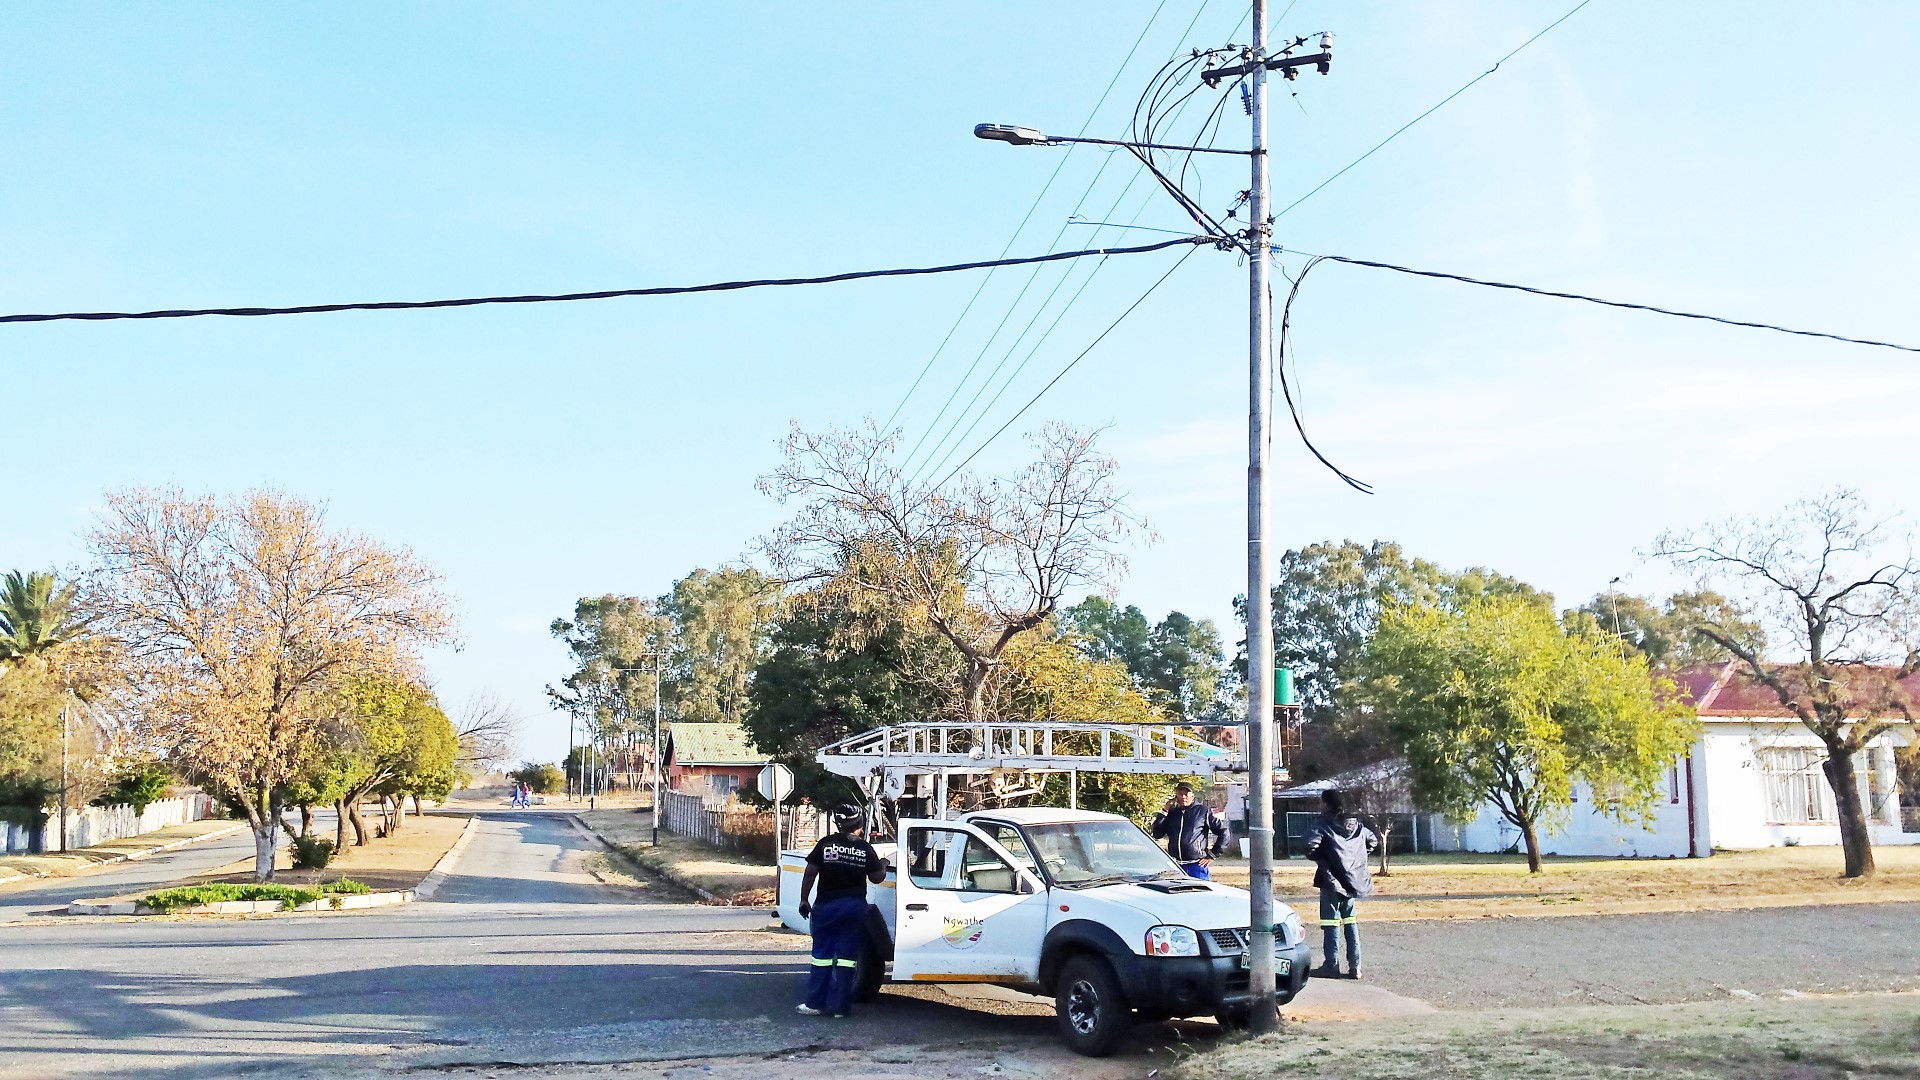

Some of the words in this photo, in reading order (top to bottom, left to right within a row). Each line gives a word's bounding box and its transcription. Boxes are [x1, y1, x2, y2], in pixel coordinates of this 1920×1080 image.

[832, 843, 866, 857] bonitas
[943, 916, 984, 928] Ngwathe
[1280, 961, 1290, 974] FS
